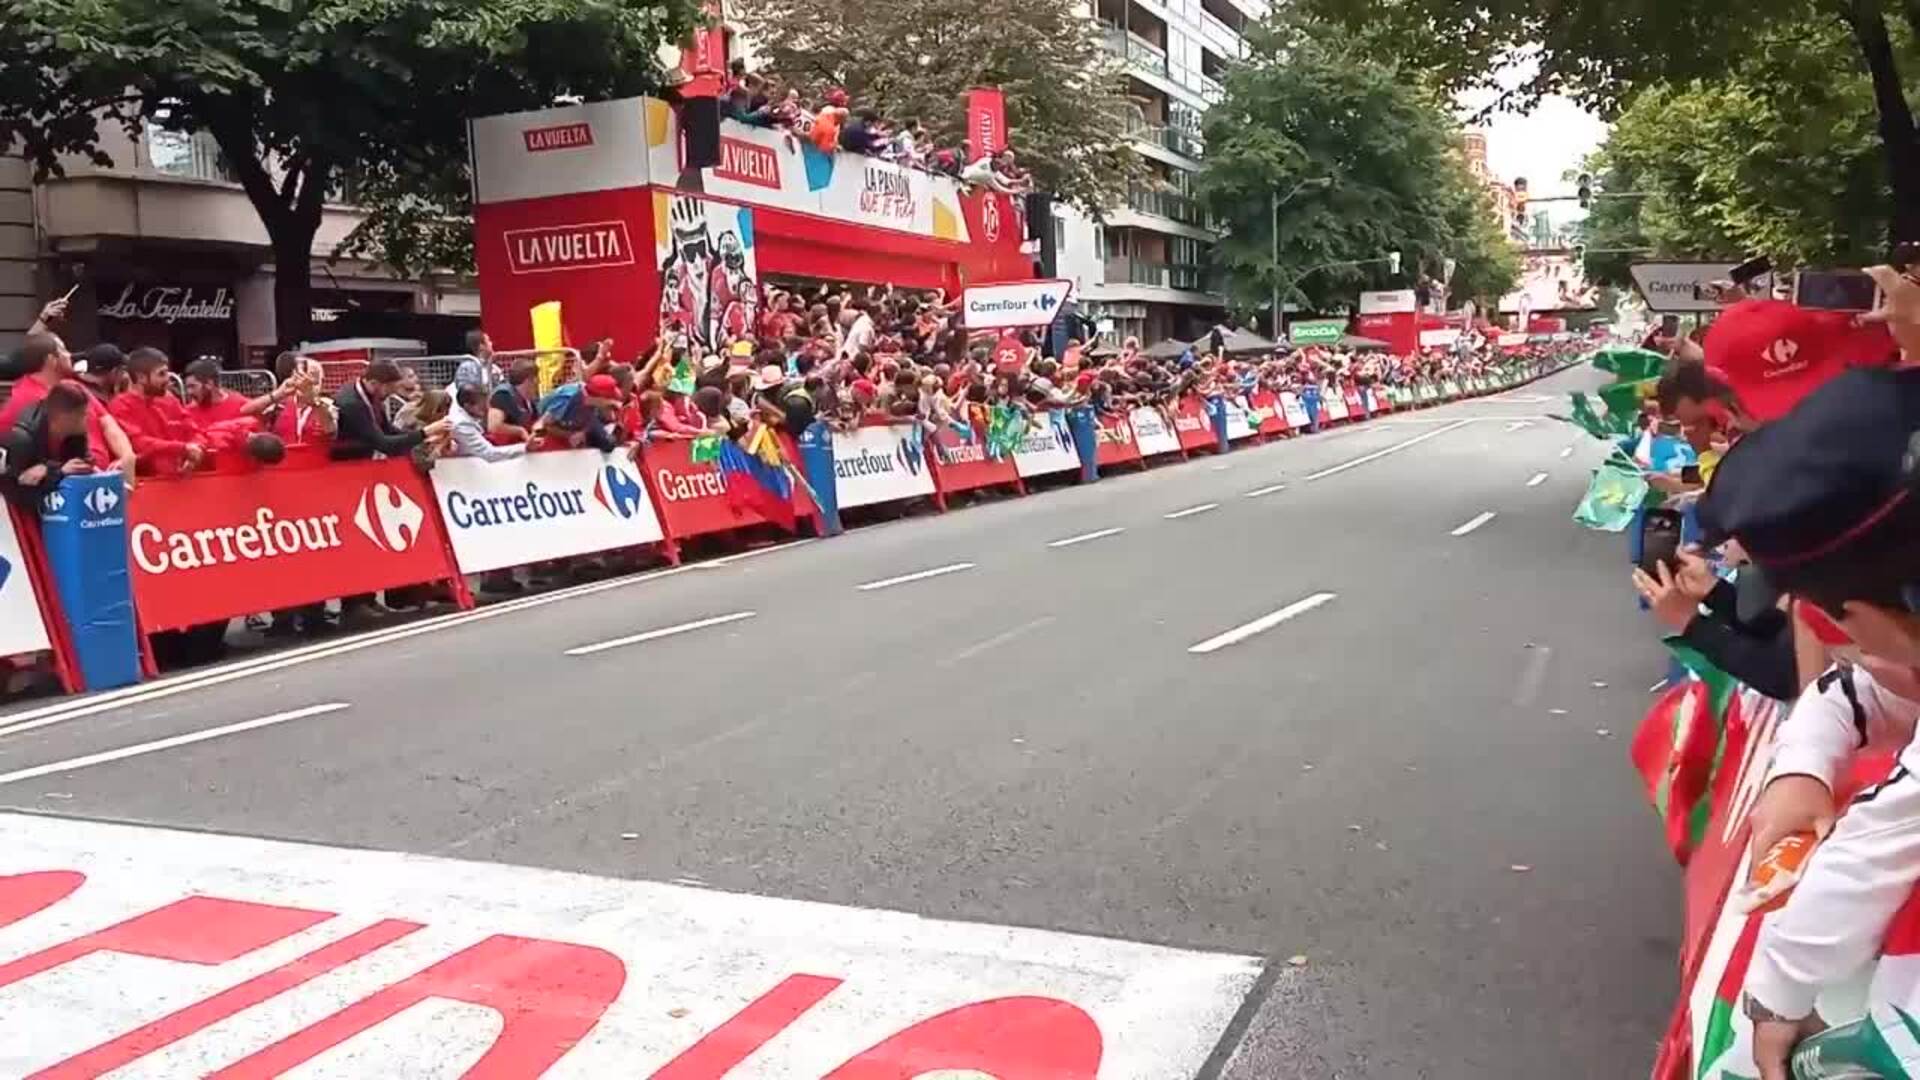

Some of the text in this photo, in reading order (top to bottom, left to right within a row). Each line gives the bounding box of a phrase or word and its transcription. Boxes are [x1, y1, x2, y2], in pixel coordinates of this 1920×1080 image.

[529, 127, 588, 149] LA VUELTA
[717, 143, 777, 182] A VUELTA
[864, 167, 877, 192] LA
[518, 230, 621, 265] LA VUELTA
[97, 281, 138, 319] La
[969, 299, 1028, 313] Carrefour
[999, 349, 1018, 362] 25
[834, 447, 894, 479] arrefour
[449, 482, 586, 530] Carrefour
[131, 507, 343, 575] Carrefour
